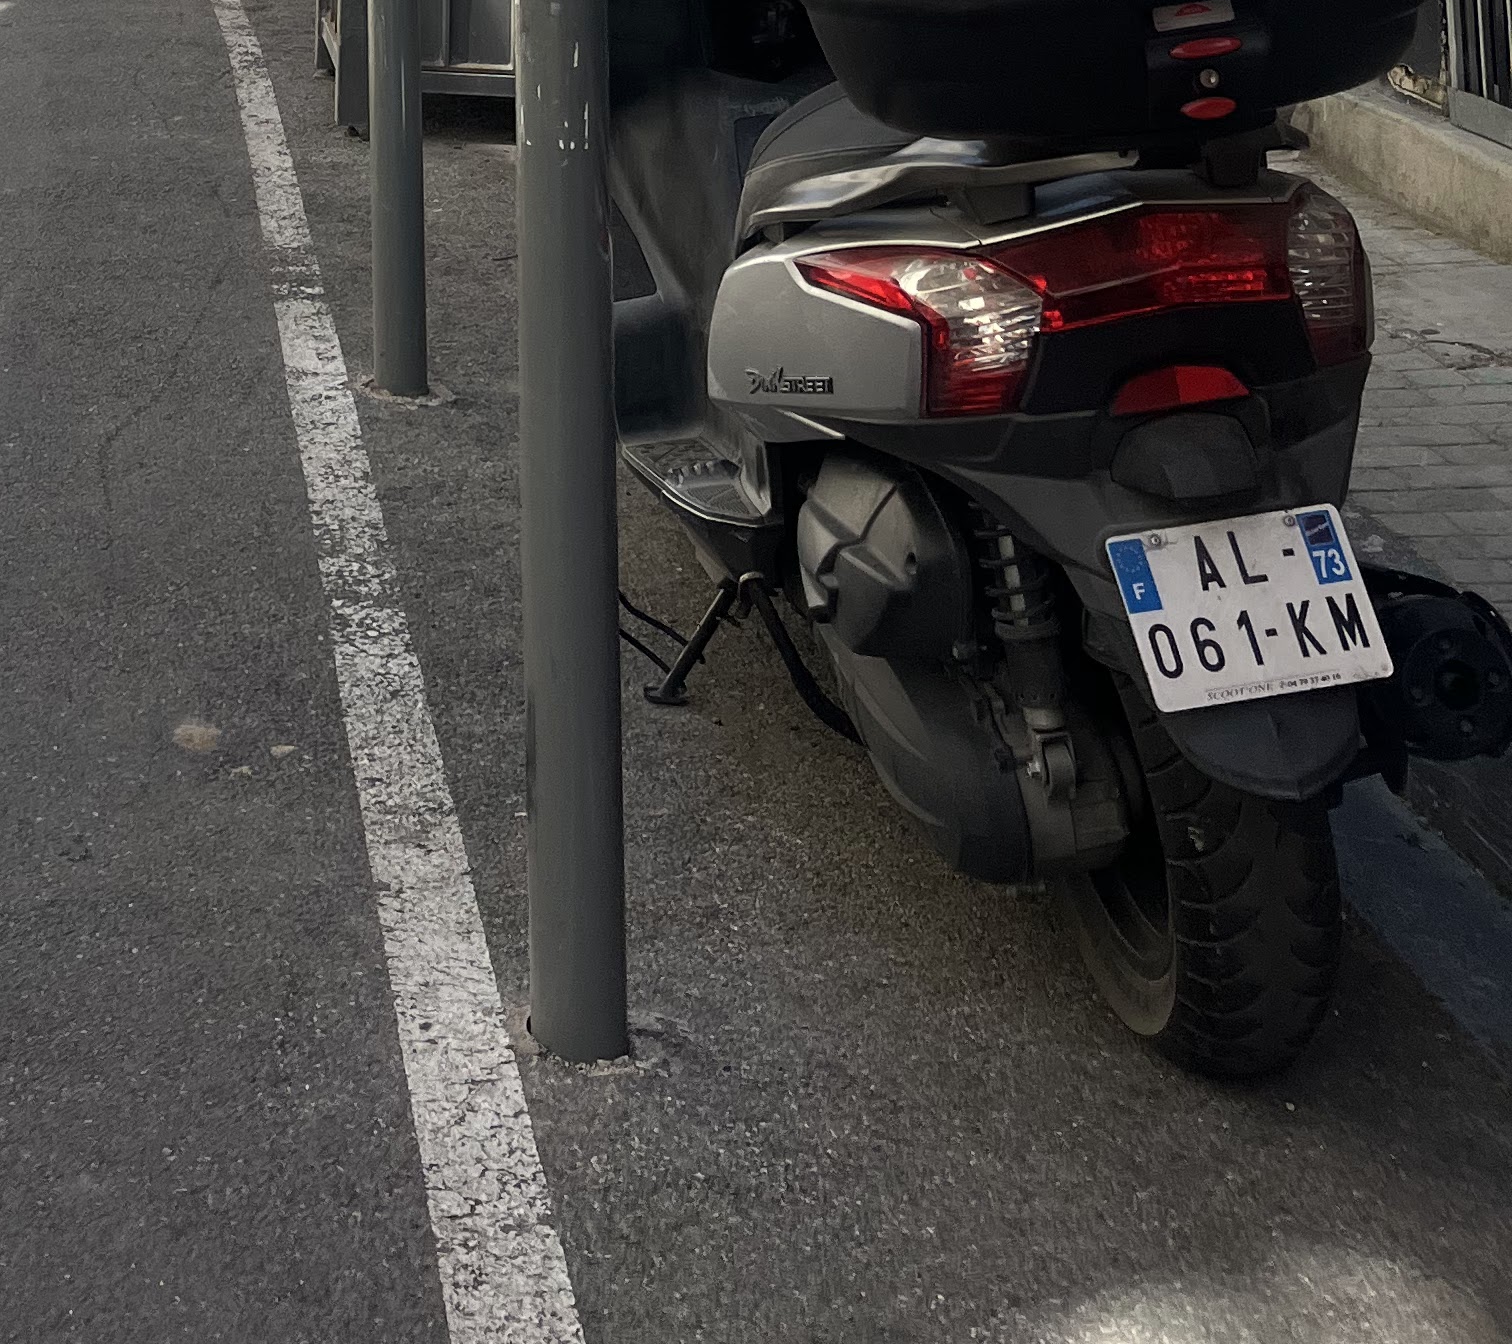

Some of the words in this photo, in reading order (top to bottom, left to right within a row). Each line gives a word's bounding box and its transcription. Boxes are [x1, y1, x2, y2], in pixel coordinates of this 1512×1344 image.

[1312, 548, 1346, 579] 73
[1132, 582, 1146, 600] F
[1148, 593, 1371, 680] 061-KM
